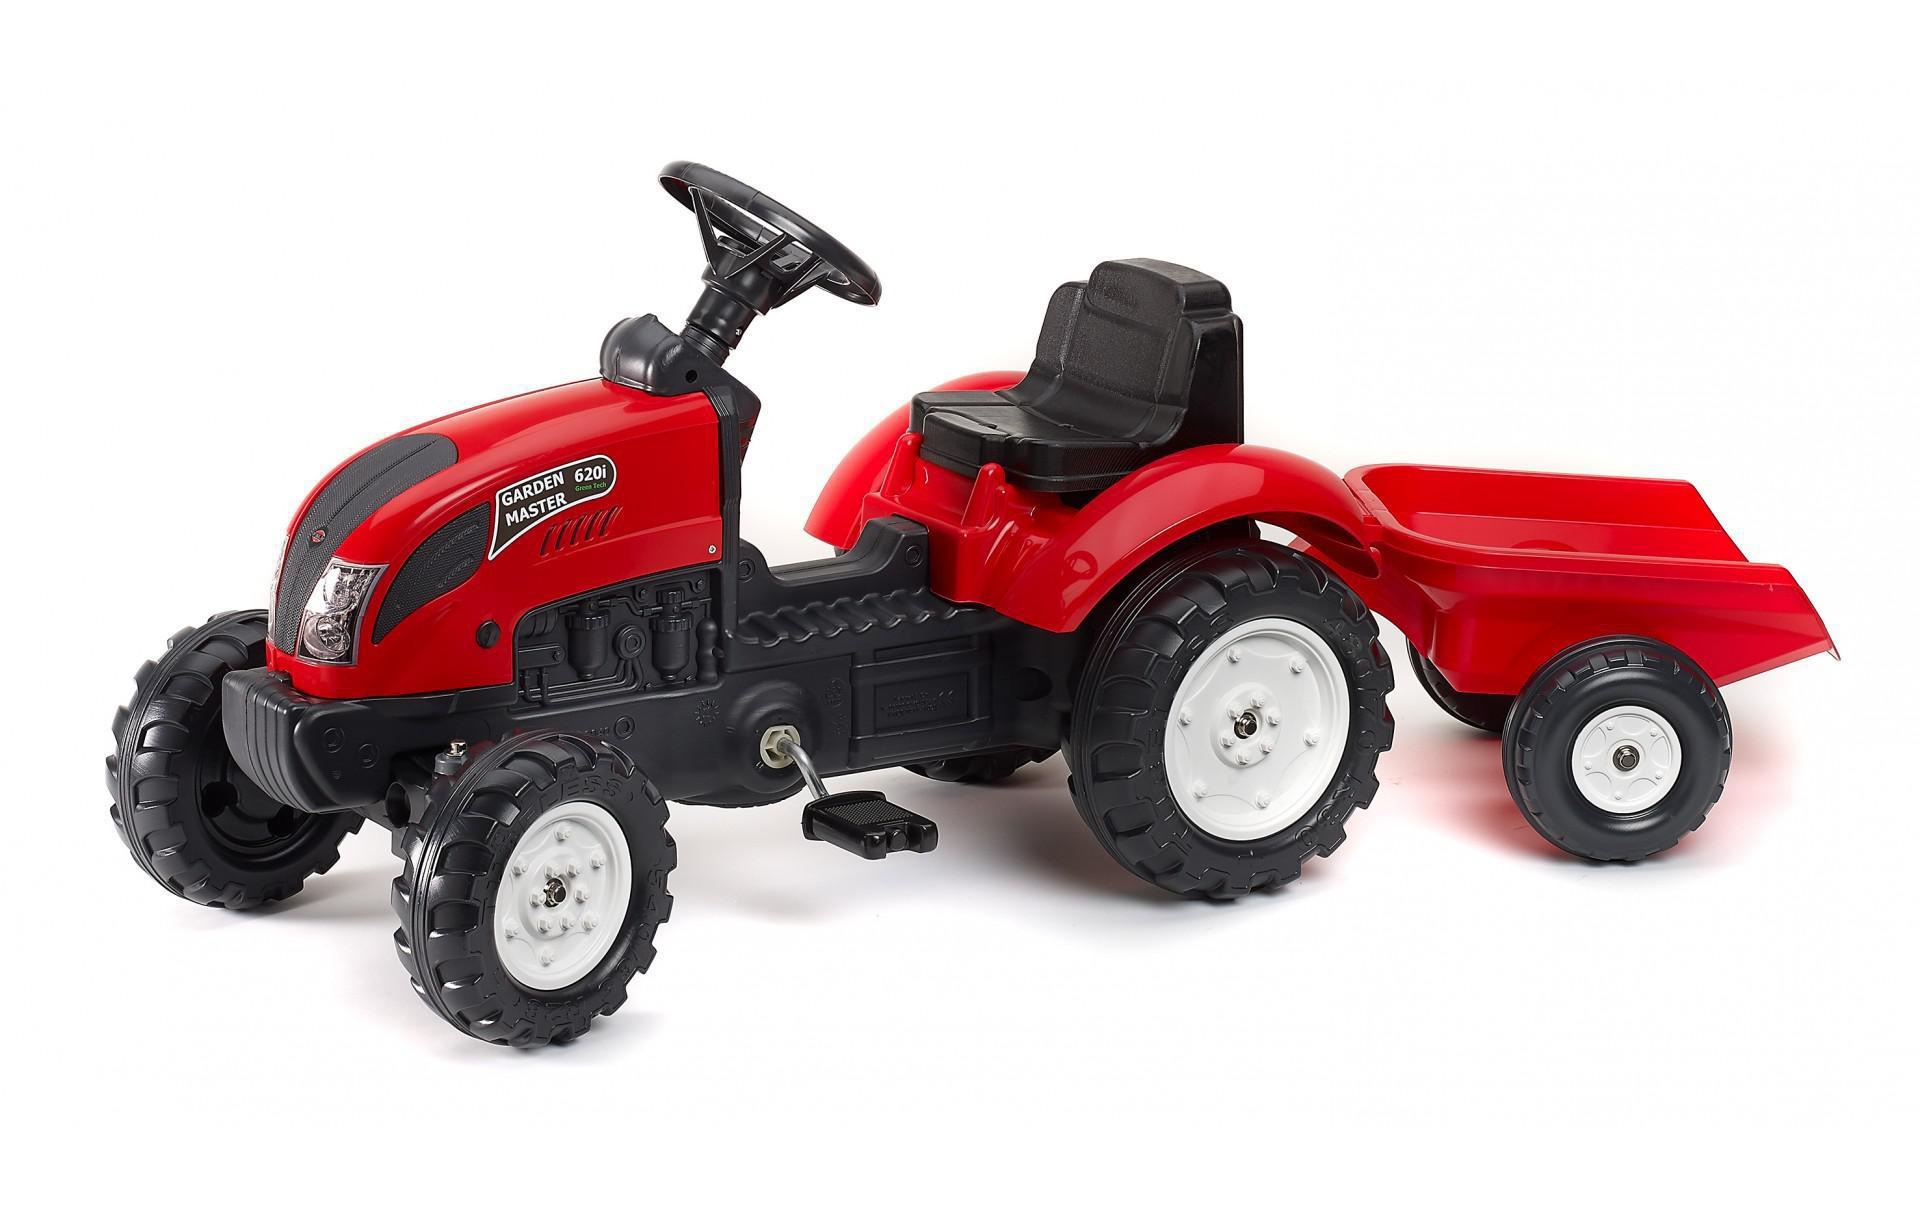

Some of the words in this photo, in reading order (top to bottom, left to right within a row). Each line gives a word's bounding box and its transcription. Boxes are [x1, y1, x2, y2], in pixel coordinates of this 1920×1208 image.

[574, 464, 607, 483] 620i
[593, 481, 607, 489] Tech
[501, 471, 565, 506] GARDEN
[504, 492, 568, 527] MASTER
